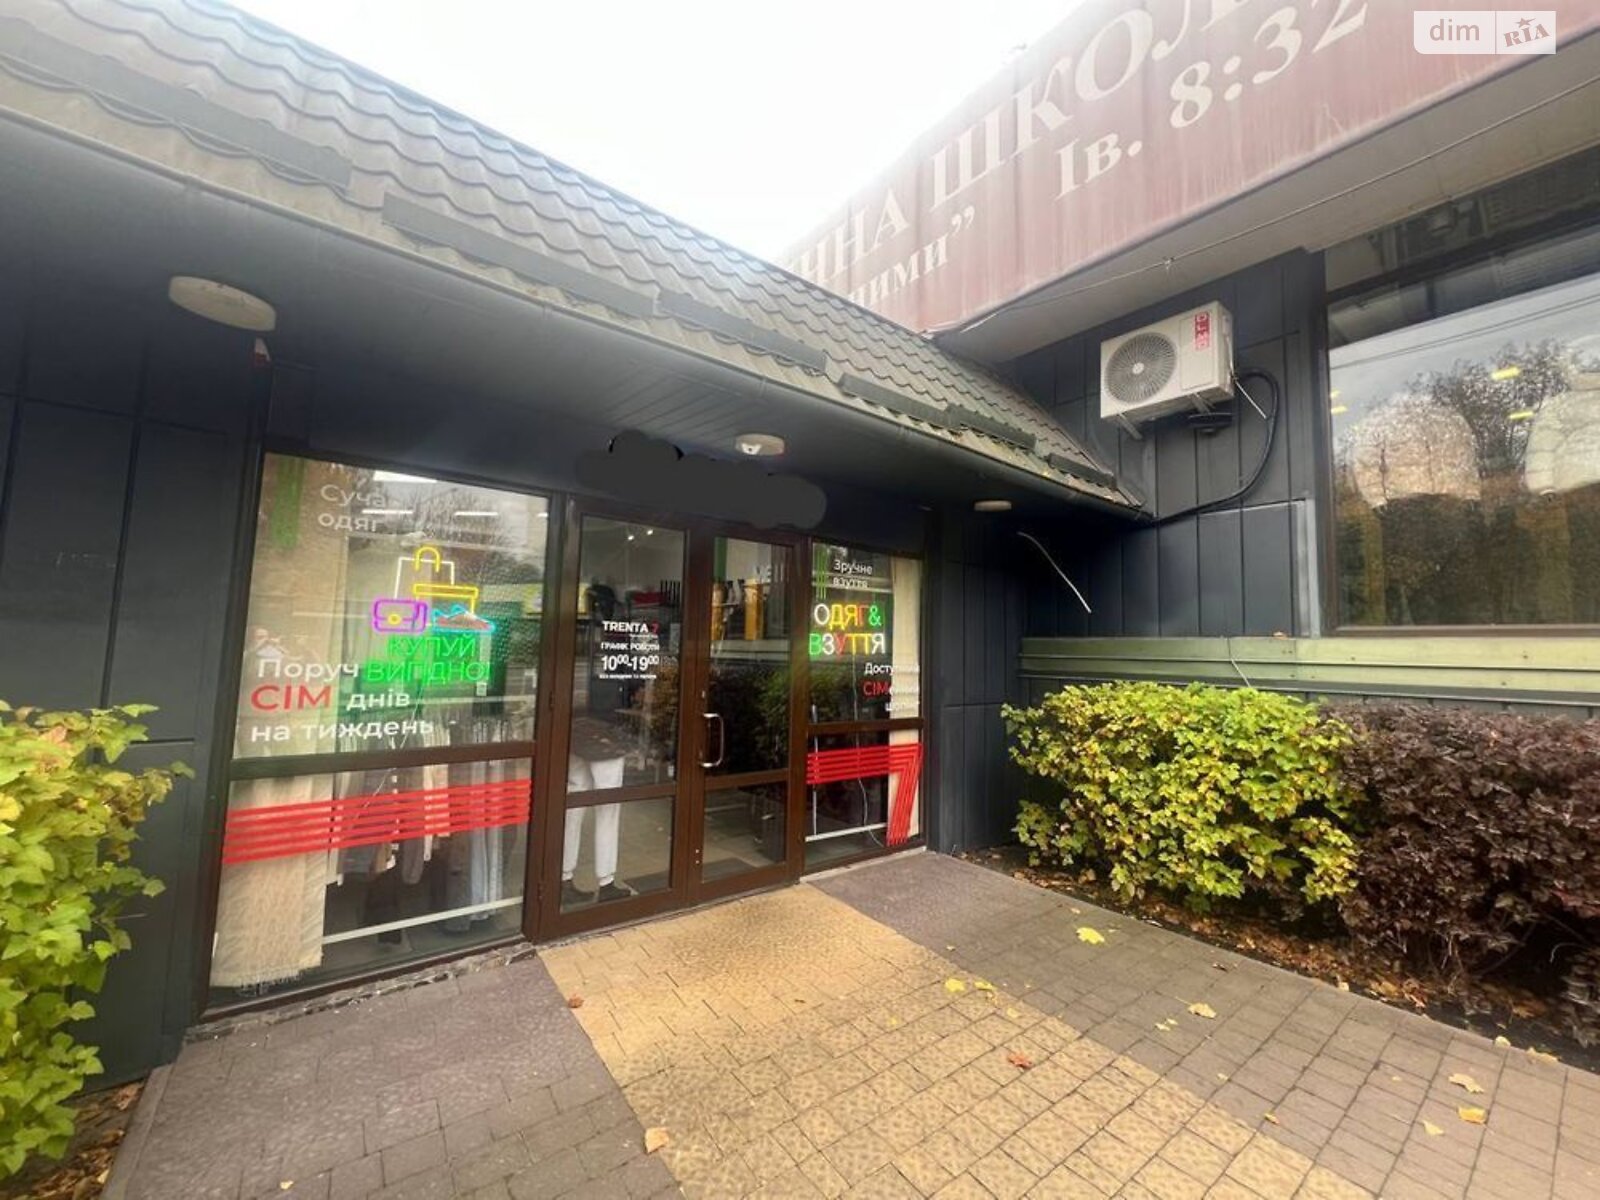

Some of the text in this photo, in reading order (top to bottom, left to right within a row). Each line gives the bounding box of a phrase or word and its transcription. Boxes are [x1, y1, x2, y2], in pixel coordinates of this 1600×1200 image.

[1054, 131, 1143, 202] Ів.
[1169, 0, 1368, 129] 8:32
[833, 559, 873, 575] Зручне
[602, 621, 649, 633] TRENTA
[389, 633, 476, 657] КУПУЙ
[809, 632, 886, 656] ВЗУТТЯ
[258, 658, 360, 682] Поруч
[250, 685, 411, 711] СІМ днів
[251, 719, 434, 742] на тиждень
